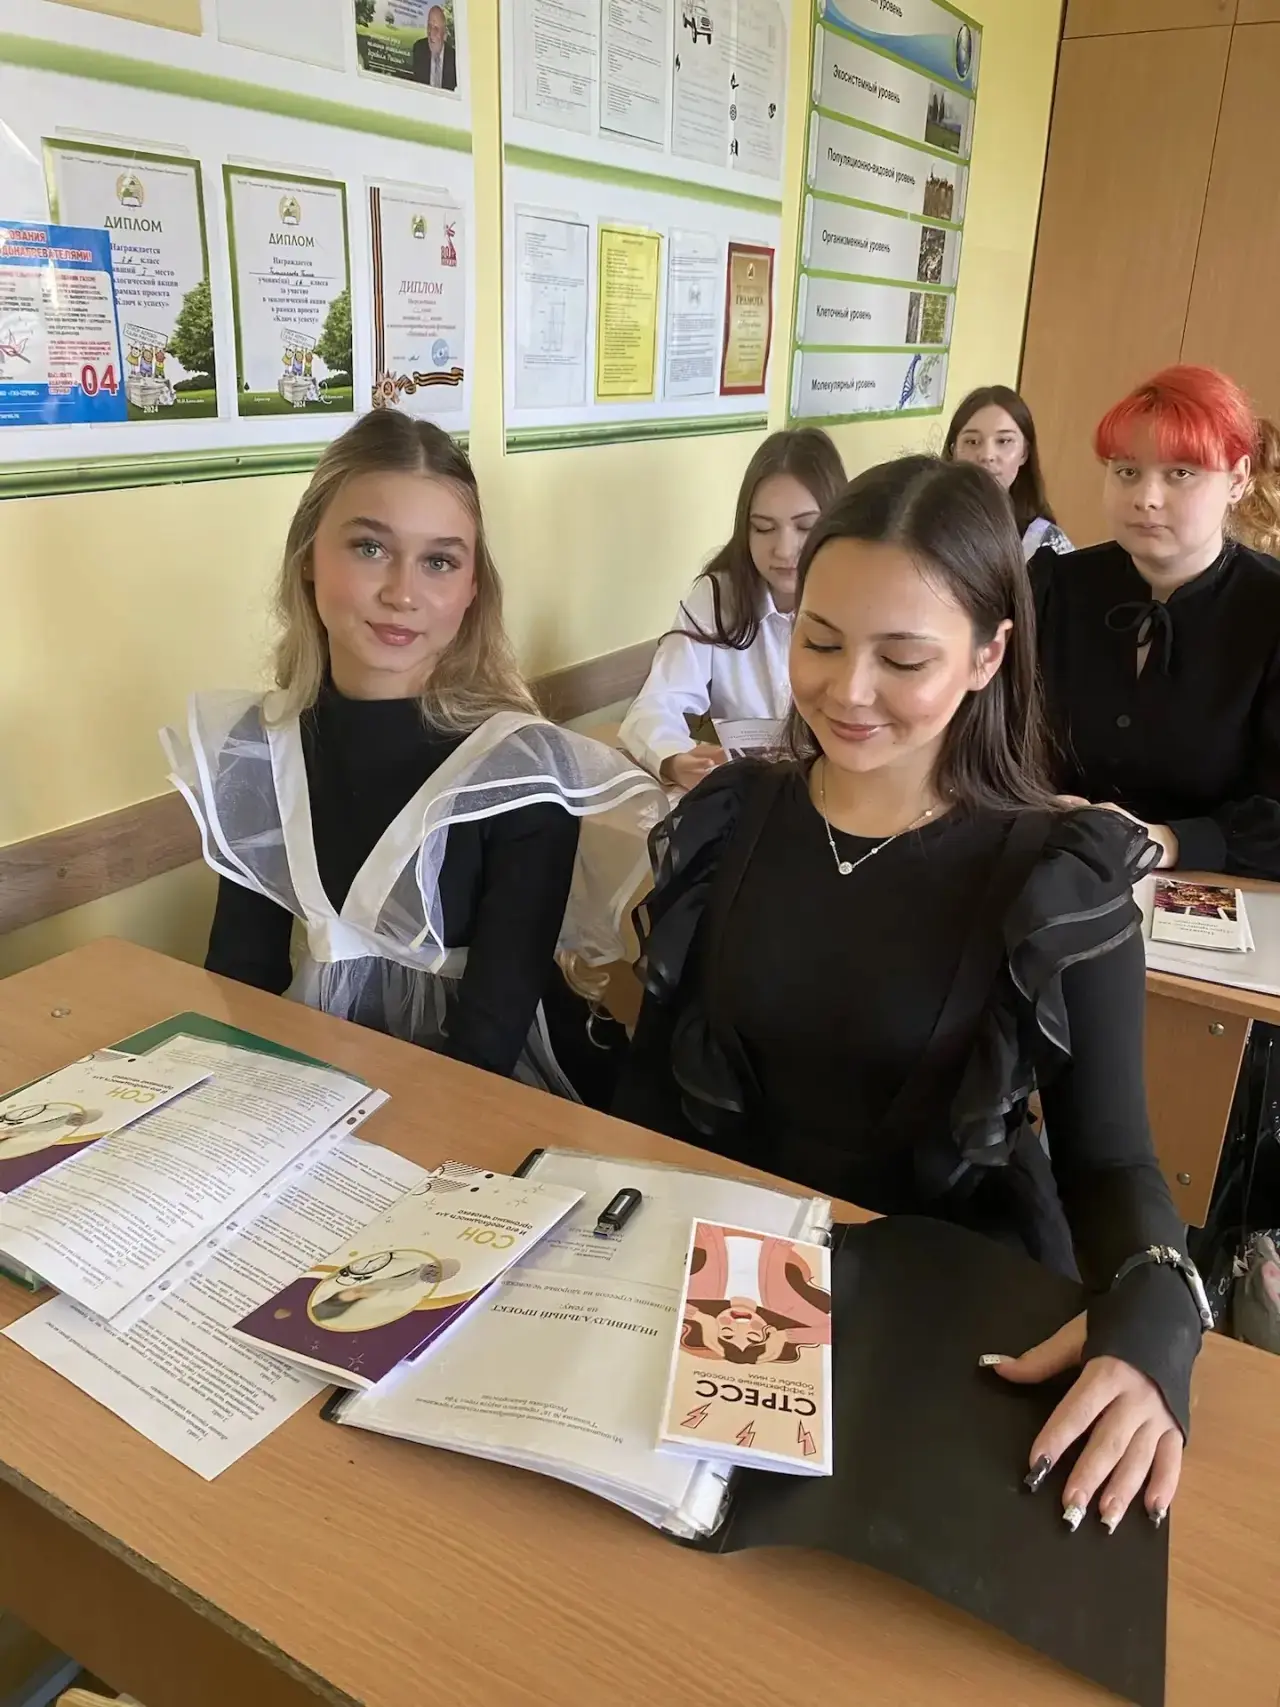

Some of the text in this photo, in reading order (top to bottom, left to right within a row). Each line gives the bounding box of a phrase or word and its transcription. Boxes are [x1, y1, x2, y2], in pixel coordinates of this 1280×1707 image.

[833, 64, 901, 104] Экосистемный уровень
[827, 147, 915, 186] Популяционно-видовой уровень
[104, 215, 163, 233] ДИПЛОМ
[269, 232, 315, 248] ДИПЛОМ
[822, 229, 891, 253] Организменный уровень
[0, 245, 91, 261] ДОНАГРЕВАТЕЛЯМИ!
[114, 278, 155, 288] логической
[399, 280, 444, 296] ДИПЛОМ
[735, 294, 764, 306] ГРАМОТА
[816, 304, 872, 321] Клеточный уровень
[82, 365, 118, 395] 04
[811, 379, 876, 392] Молекулярный уровень
[143, 405, 158, 413] 2024
[106, 1087, 155, 1103] СОН
[450, 1215, 505, 1229] необходимость
[458, 1209, 533, 1230] организма человека
[456, 1227, 515, 1248] СОН
[544, 1284, 581, 1296] здоровье
[595, 1291, 633, 1303] стрессов
[559, 1302, 585, 1312] тему:
[490, 1304, 658, 1337] ИНДИВИДУАЛЬНЫЙ ПРОЕКТ
[692, 1370, 736, 1381] способы
[737, 1379, 806, 1395] эффективные
[778, 1379, 814, 1390] борьбы
[695, 1380, 816, 1416] СТРЕСС
